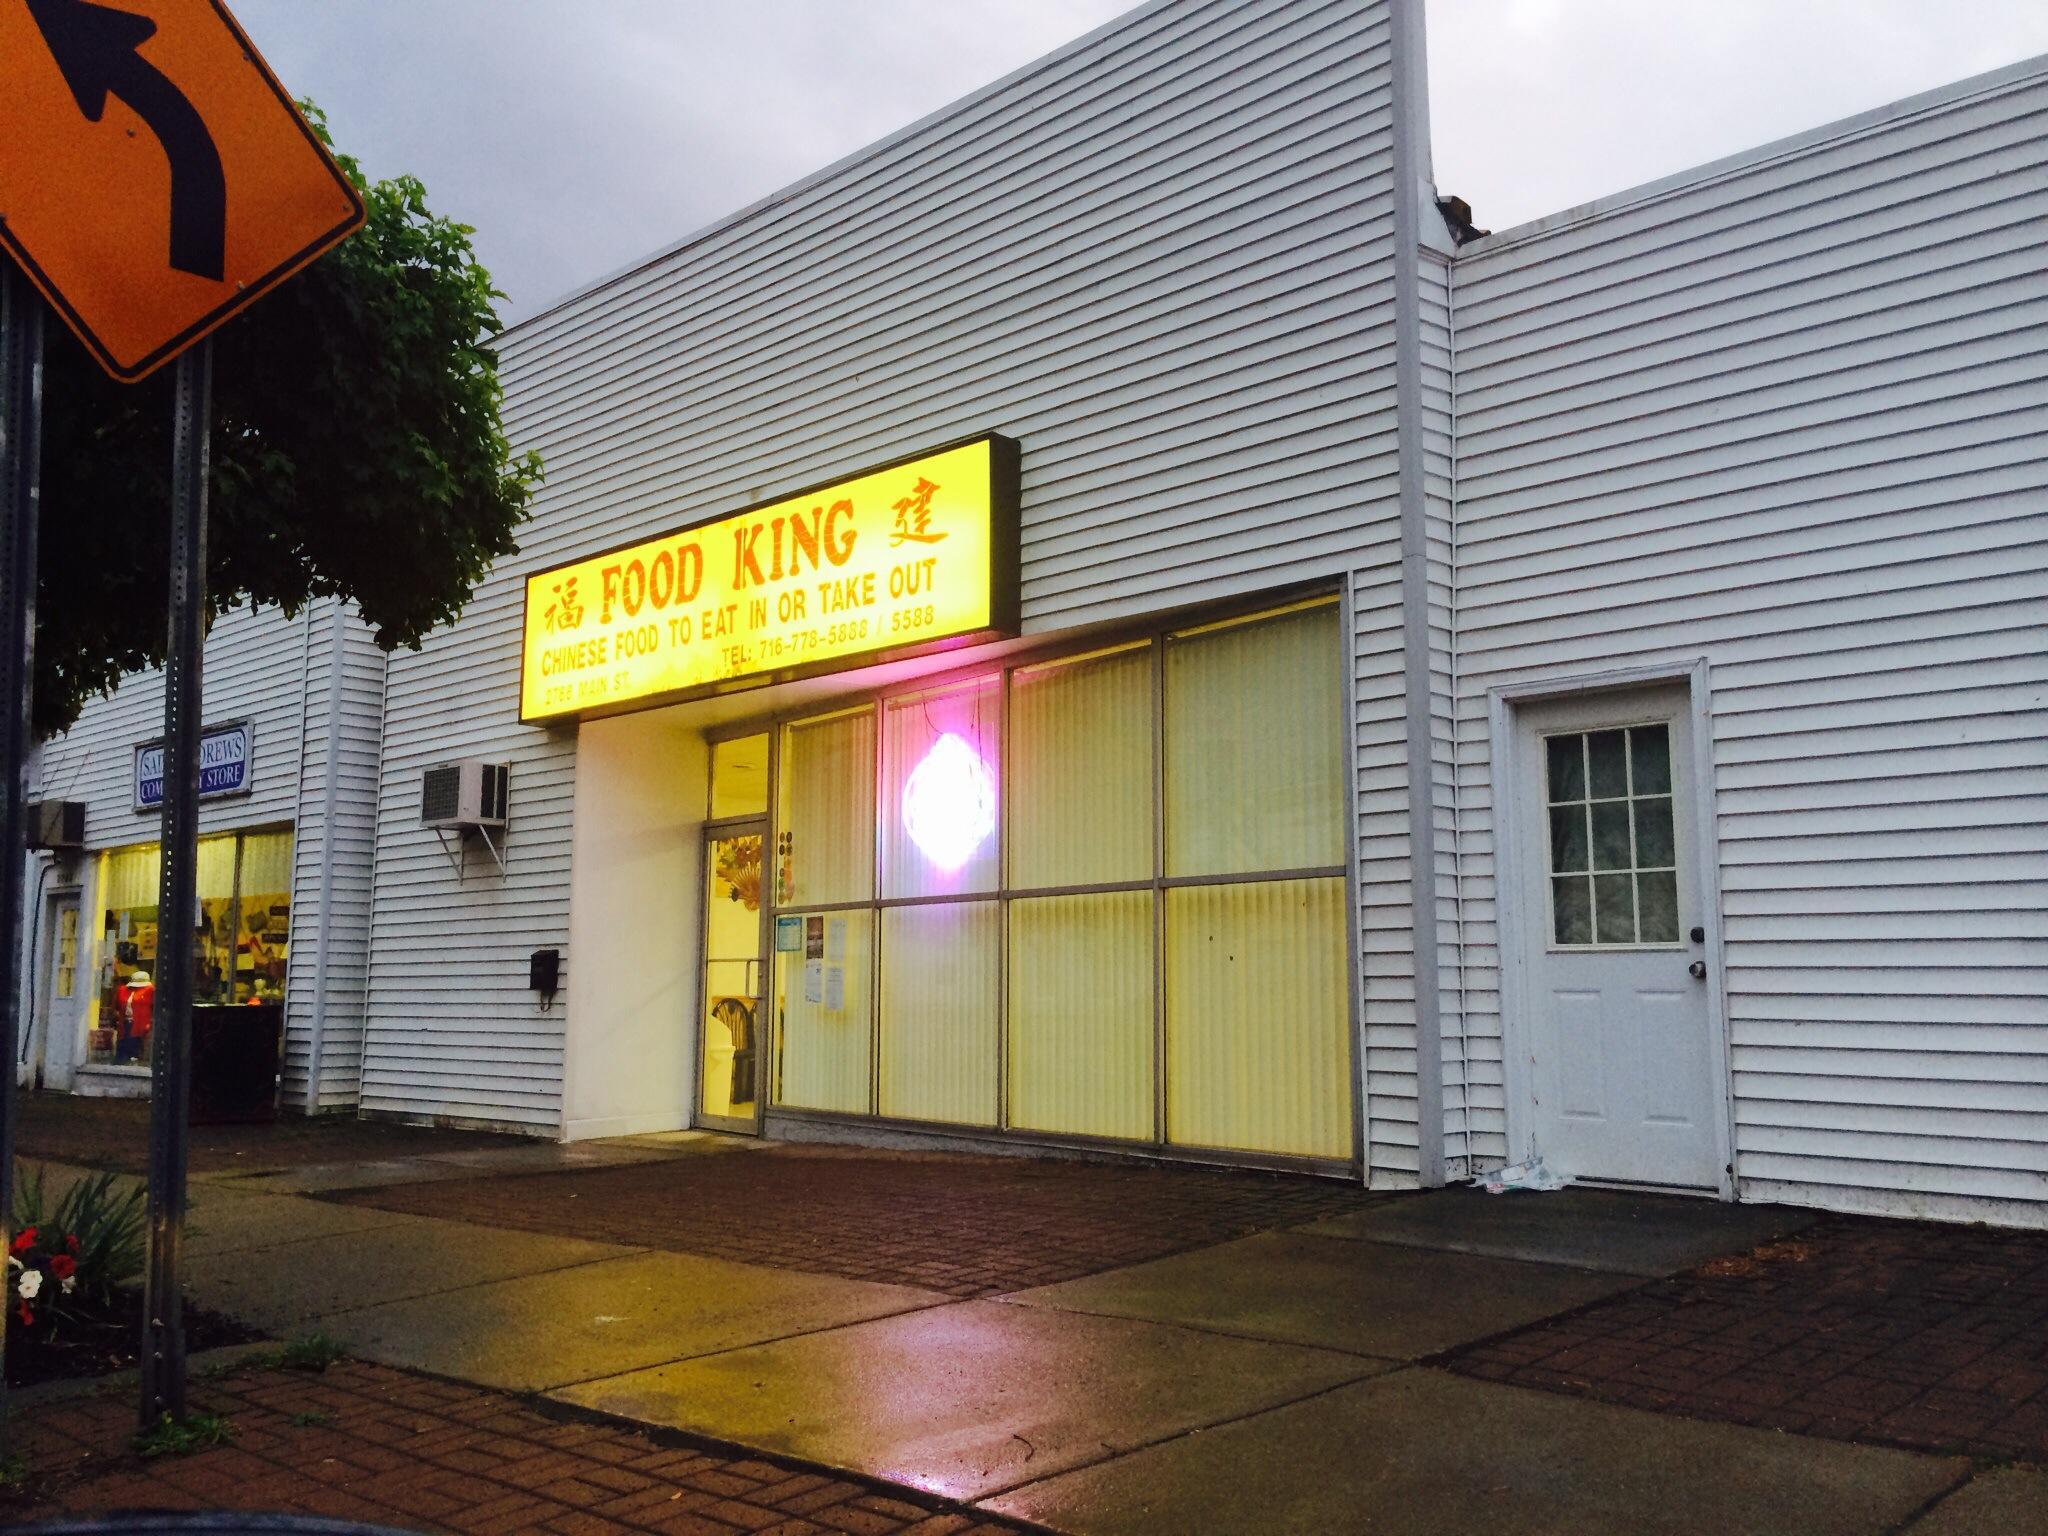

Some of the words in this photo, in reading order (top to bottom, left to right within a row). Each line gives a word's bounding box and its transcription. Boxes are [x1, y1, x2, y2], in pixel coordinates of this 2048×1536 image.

[598, 543, 704, 625] FOOD
[732, 498, 859, 591] KING
[541, 628, 607, 678] CHINESE
[614, 622, 659, 661] FOOD
[667, 616, 692, 648] TO
[701, 609, 738, 641] EAT
[749, 600, 768, 629] IN
[778, 593, 807, 623] OR
[819, 572, 875, 613] TAKE
[889, 557, 937, 597] OUT
[544, 575, 584, 634] 福
[721, 645, 752, 667] TEL:
[759, 619, 868, 659] 716-778-5888
[891, 604, 935, 632] 5588
[579, 676, 607, 696] MAIN
[206, 765, 241, 787] STORE
